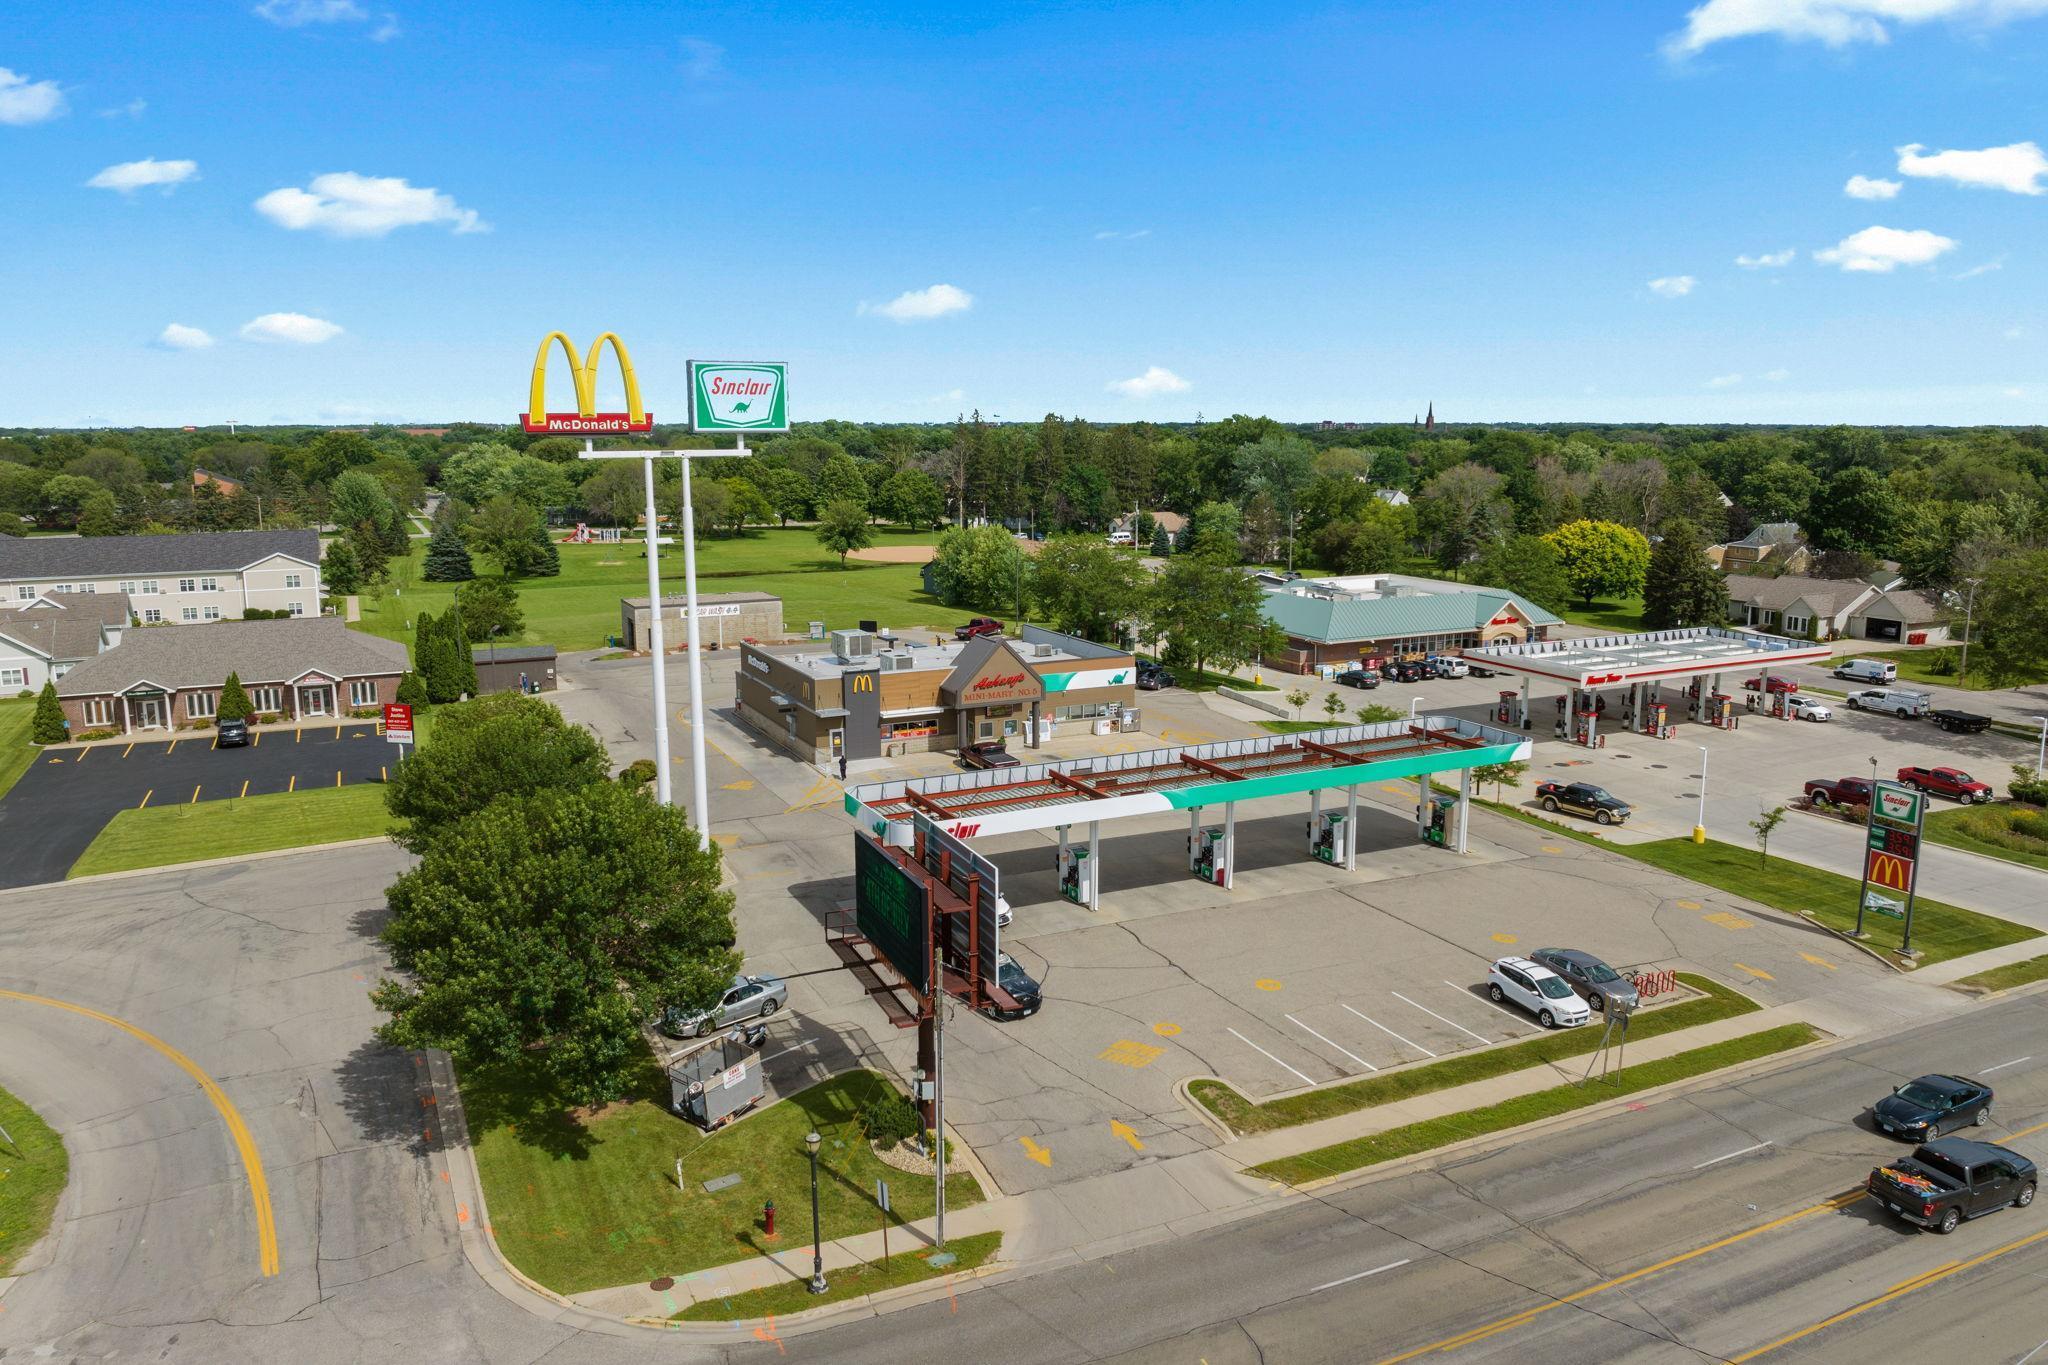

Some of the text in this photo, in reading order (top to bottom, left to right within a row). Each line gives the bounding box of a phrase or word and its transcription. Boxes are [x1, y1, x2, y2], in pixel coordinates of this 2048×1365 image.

[711, 376, 772, 396] Sinclair
[549, 418, 629, 431] McDonald's
[964, 690, 1014, 701] MINI-MART
[1883, 794, 1910, 807] Sinclair
